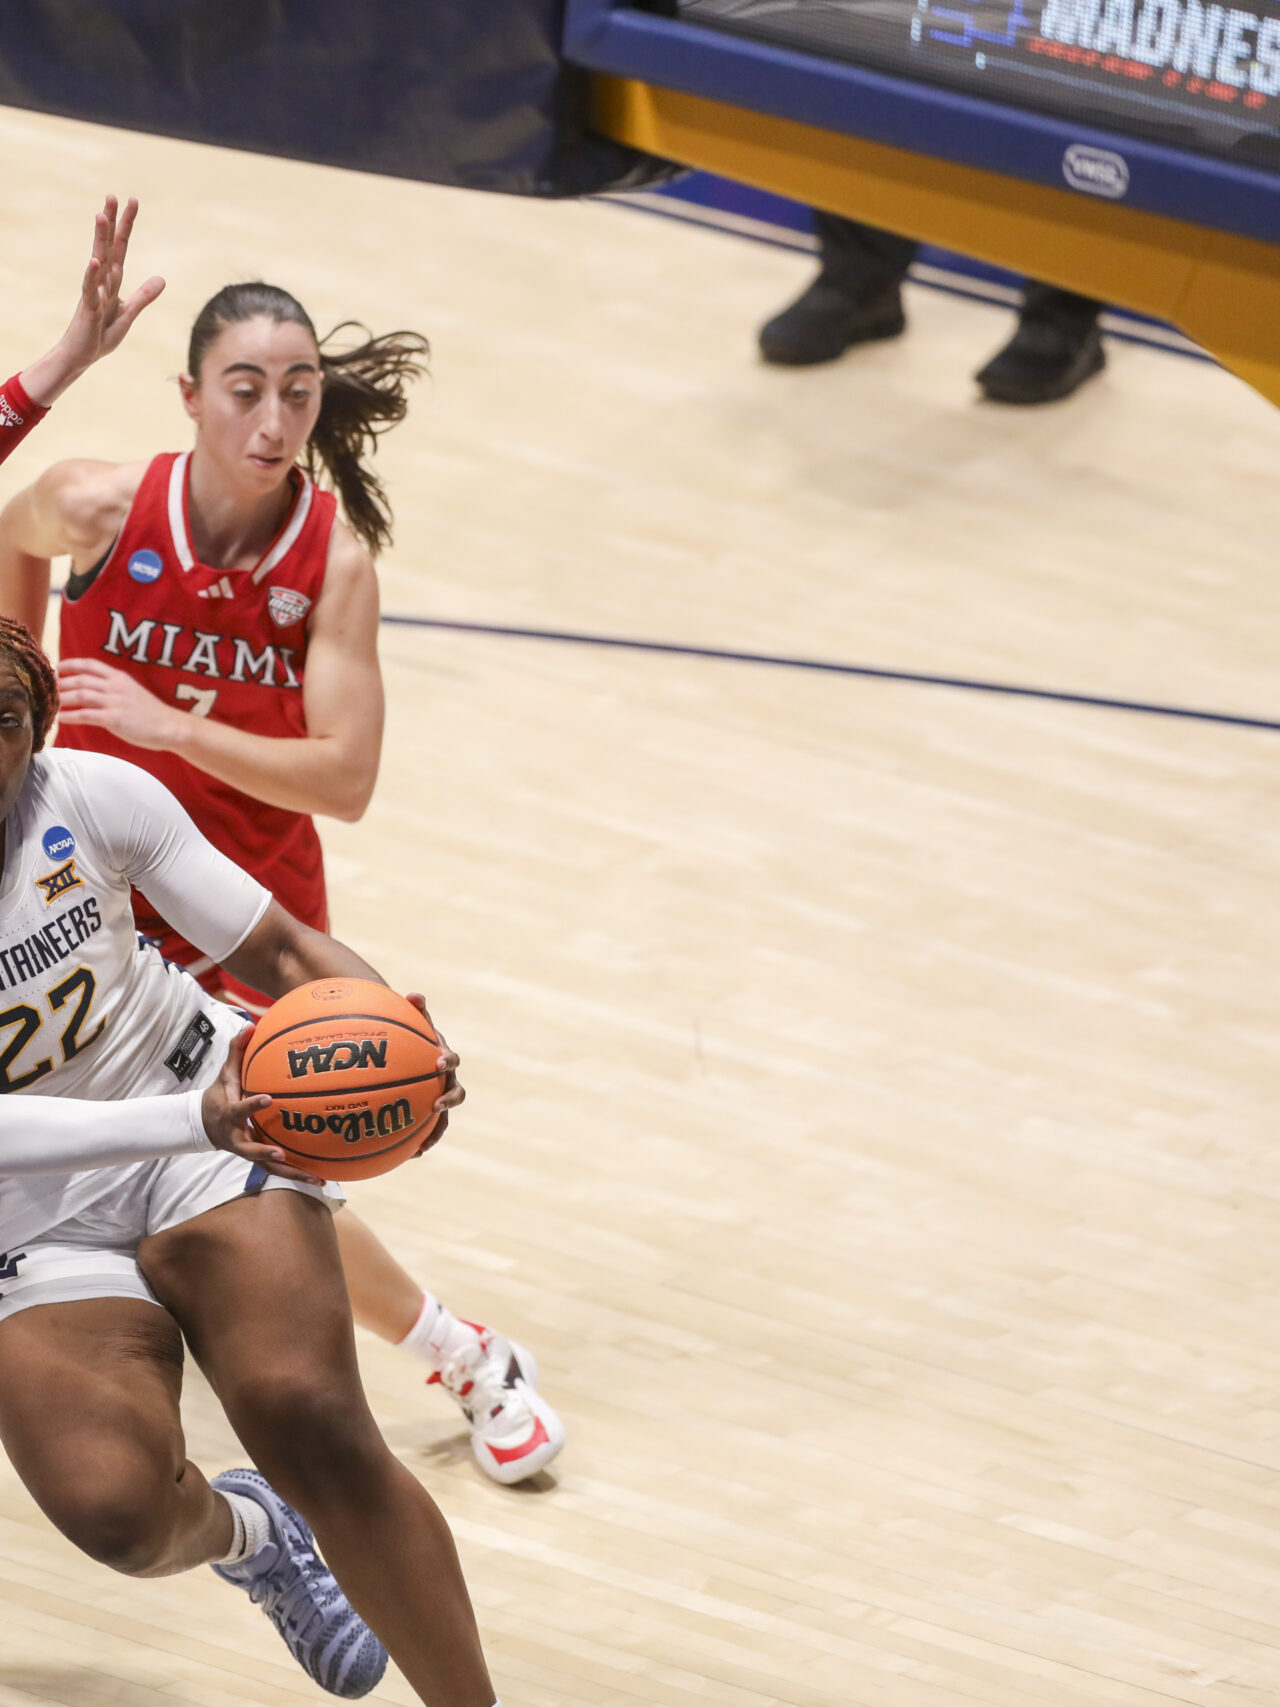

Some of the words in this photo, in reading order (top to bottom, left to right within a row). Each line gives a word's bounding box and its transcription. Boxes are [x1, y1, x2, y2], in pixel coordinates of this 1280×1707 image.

[103, 609, 302, 688] MIAMI
[174, 683, 218, 718] 7
[48, 837, 75, 855] NCAA
[37, 861, 83, 902] XII
[288, 1037, 312, 1046] BALL
[314, 1033, 343, 1041] GAME
[289, 1040, 388, 1078] NCAA
[280, 1098, 415, 1144] Wilson
